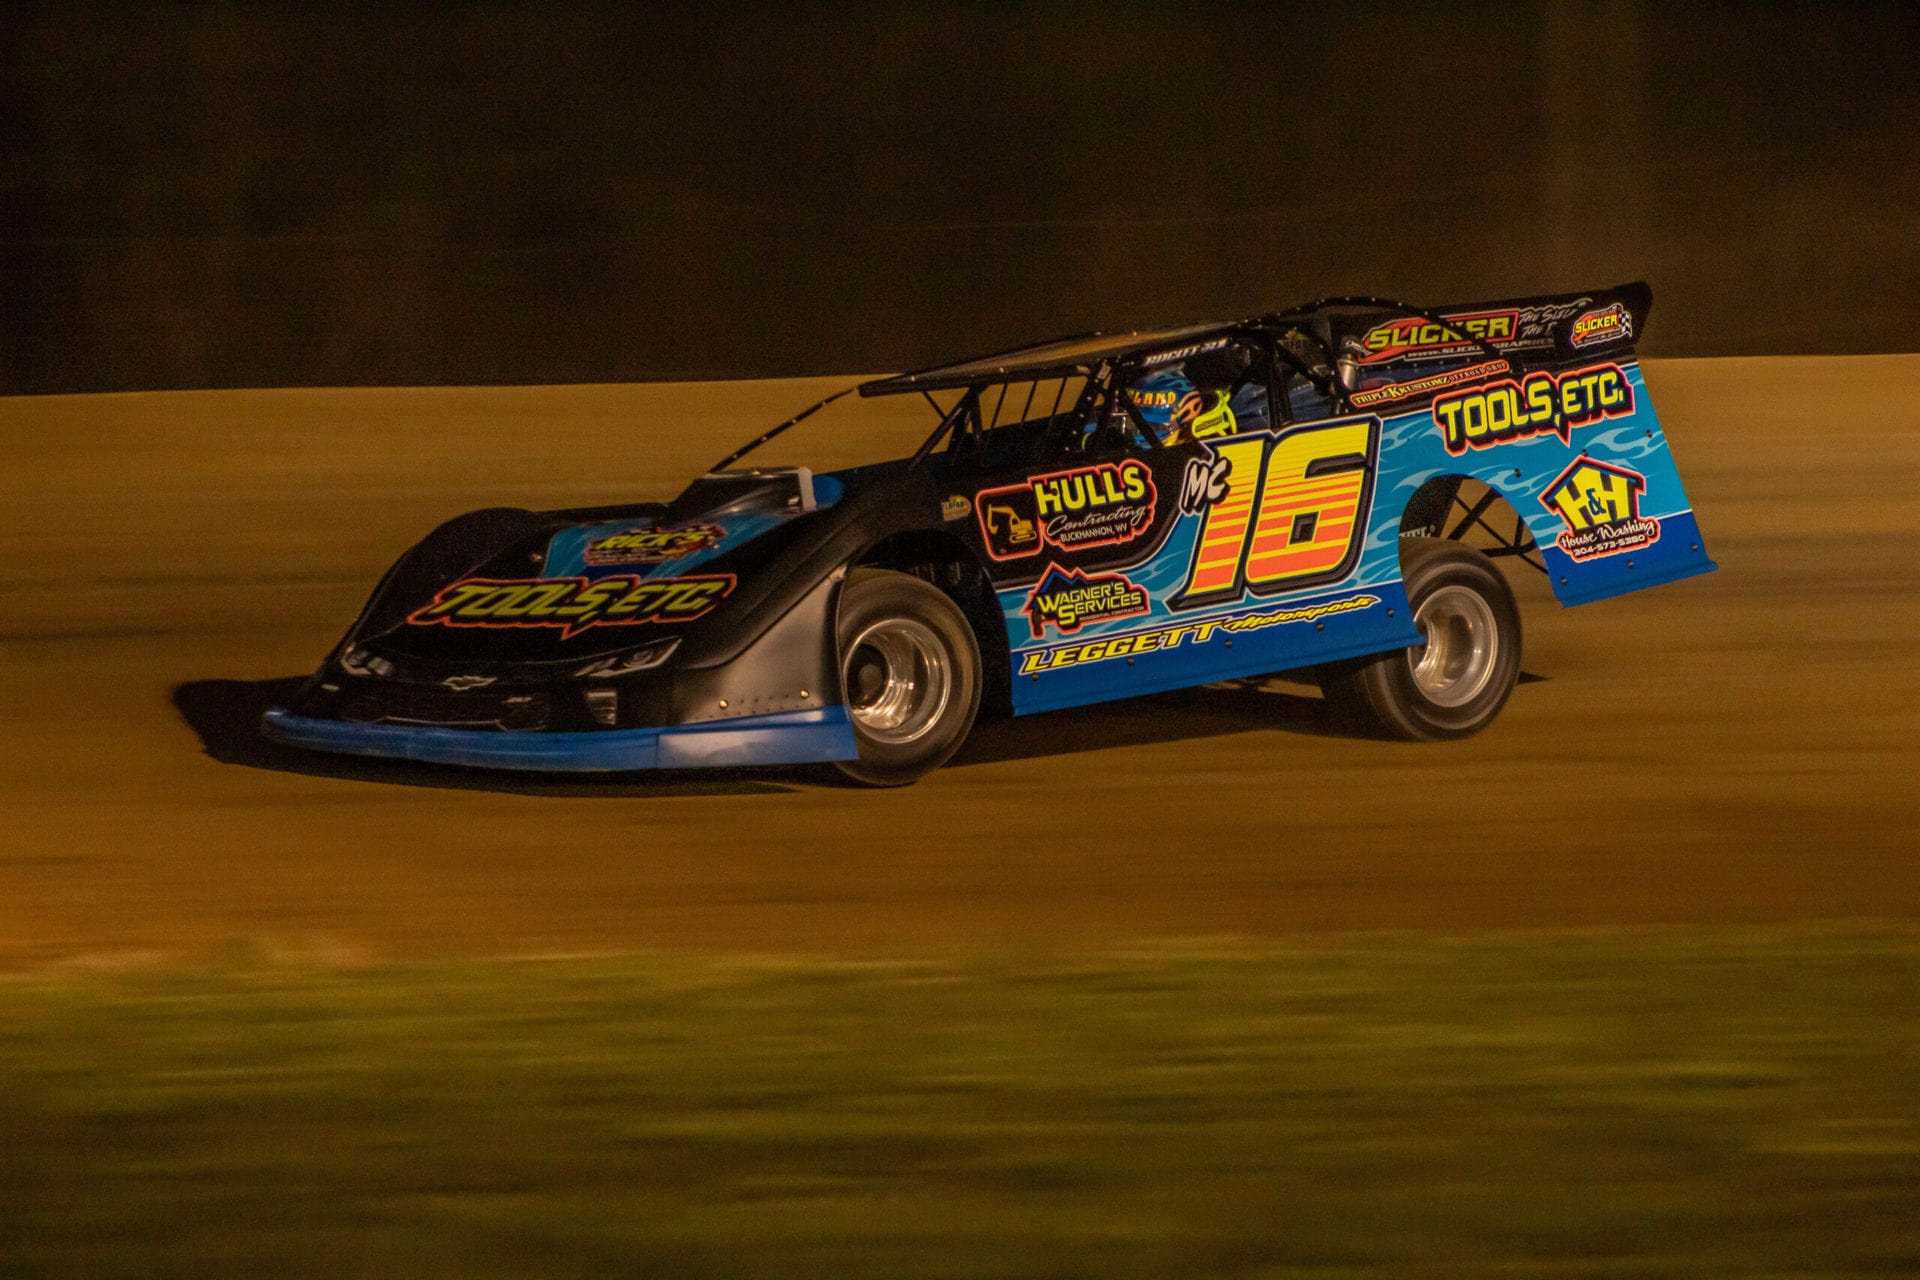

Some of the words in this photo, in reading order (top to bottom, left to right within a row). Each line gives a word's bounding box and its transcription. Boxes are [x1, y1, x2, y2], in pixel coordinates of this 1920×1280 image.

[1368, 317, 1510, 348] SLICKER
[1575, 314, 1618, 333] SLICKER
[1034, 466, 1146, 515] HULLS
[1554, 466, 1632, 530] H&H
[1046, 505, 1147, 537] Contracting
[1183, 421, 1373, 597] 16
[1060, 525, 1116, 543] BUCKHANNON,
[1114, 522, 1128, 535] WV
[1561, 531, 1598, 549] House
[1596, 518, 1656, 541] Washing
[1573, 534, 1646, 557] 304-573-5380
[1036, 581, 1126, 614] WAGNER'S
[1057, 591, 1143, 626] SERVICES
[1023, 619, 1227, 674] LEGGETT
[1223, 596, 1376, 632] Motorsports
